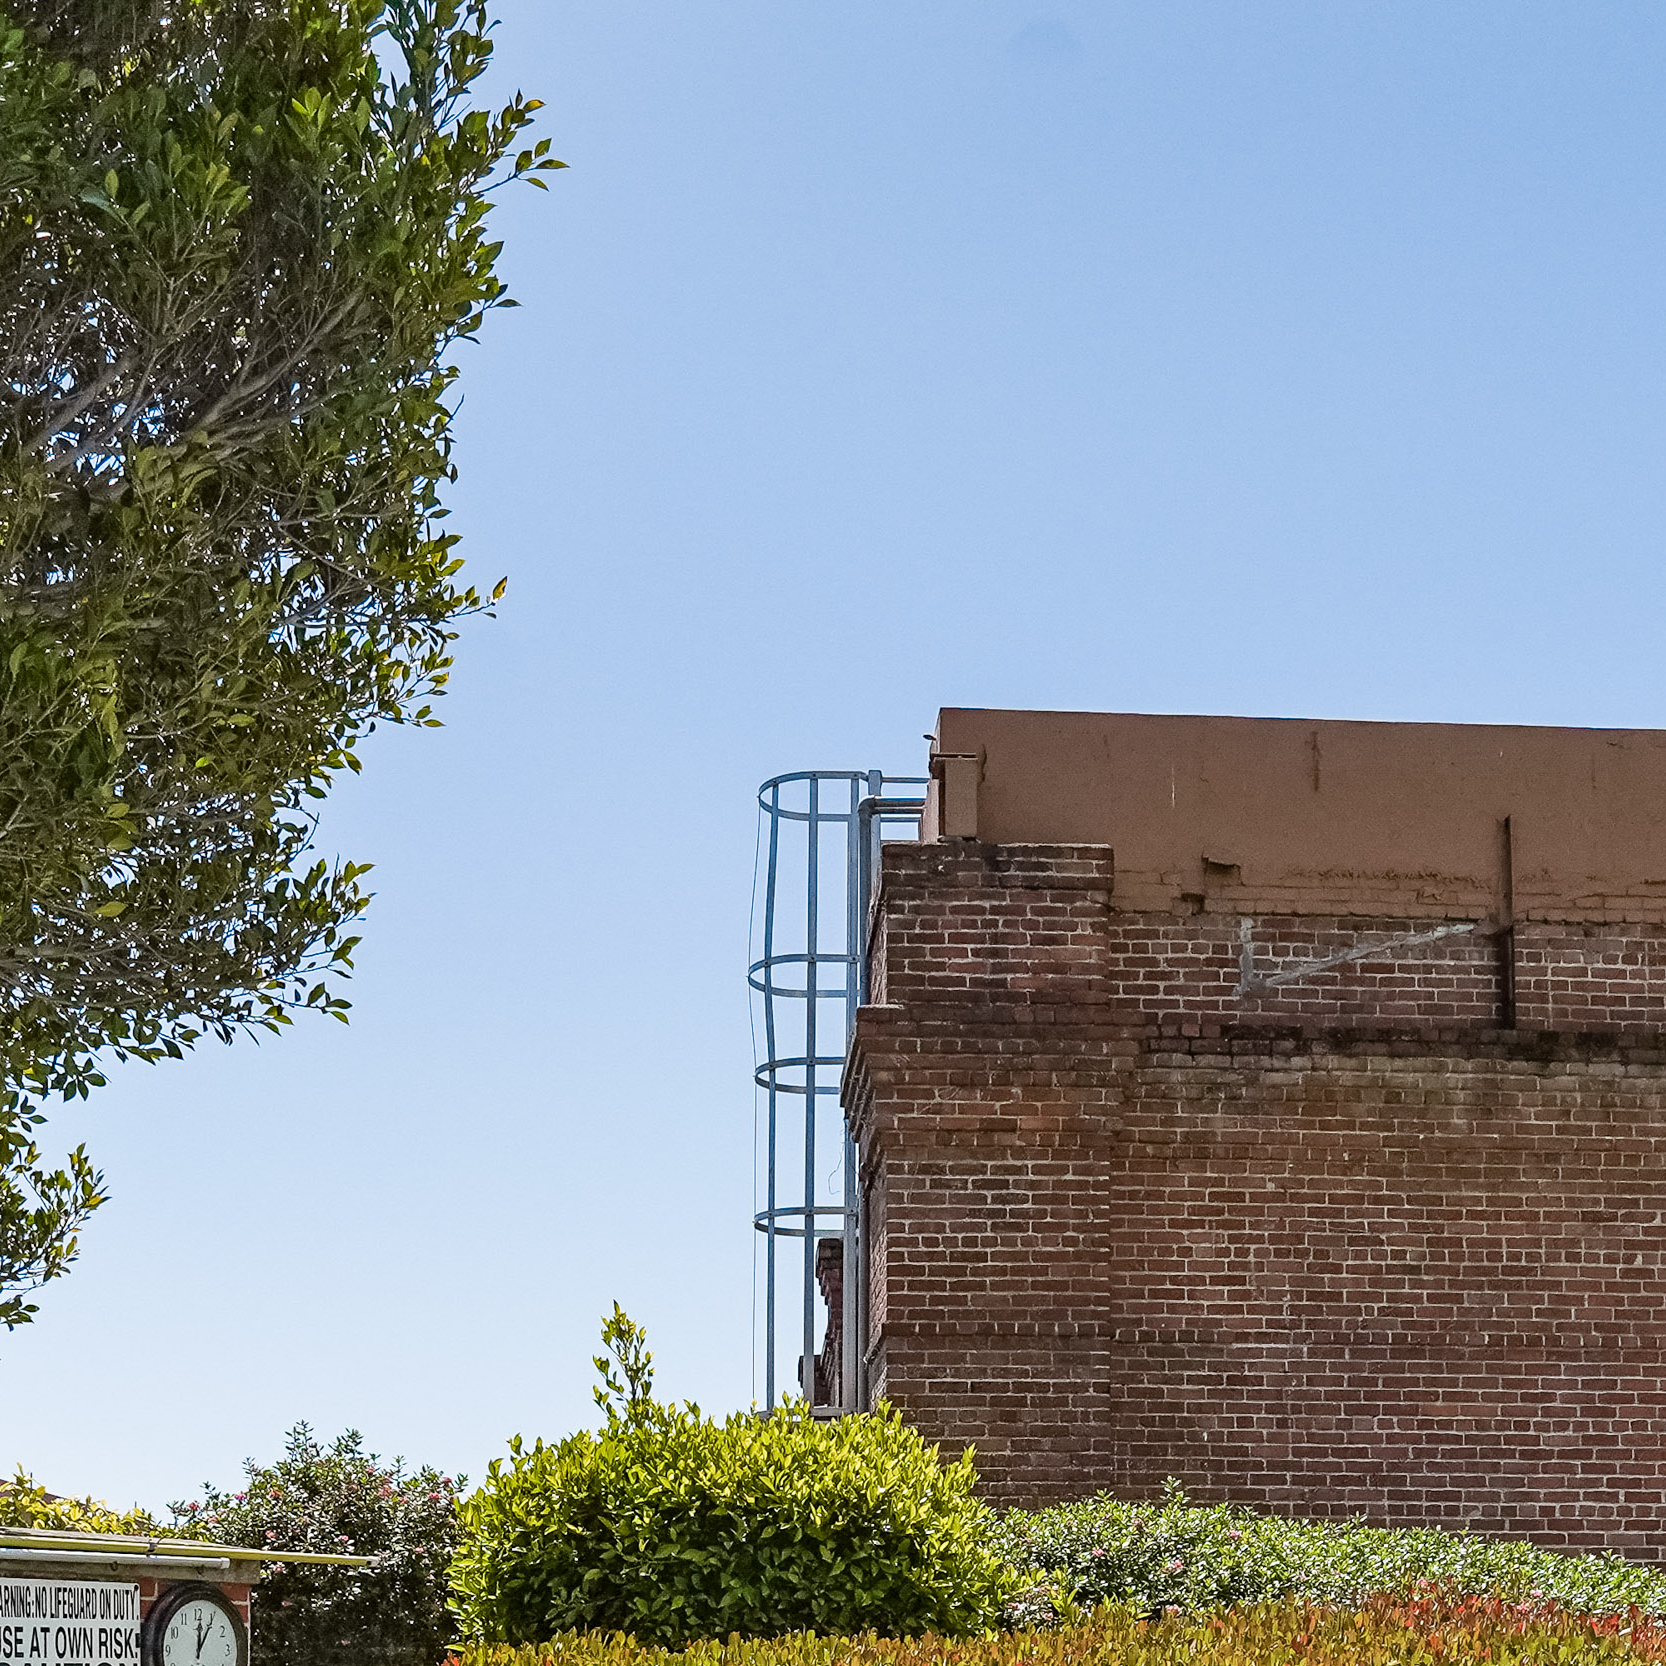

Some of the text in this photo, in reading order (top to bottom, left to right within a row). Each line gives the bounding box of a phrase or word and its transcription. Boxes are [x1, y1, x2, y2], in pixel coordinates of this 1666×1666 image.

[50, 1587, 97, 1619] LIFEGUARD
[100, 1588, 111, 1620] ON
[180, 1613, 187, 1626] 11
[194, 1607, 203, 1621] 12
[170, 1626, 179, 1640] 10
[220, 1625, 226, 1638] 2
[30, 1626, 50, 1659] AT
[55, 1626, 93, 1659] OWN
[165, 1644, 171, 1657] 9
[224, 1643, 231, 1657] 3
